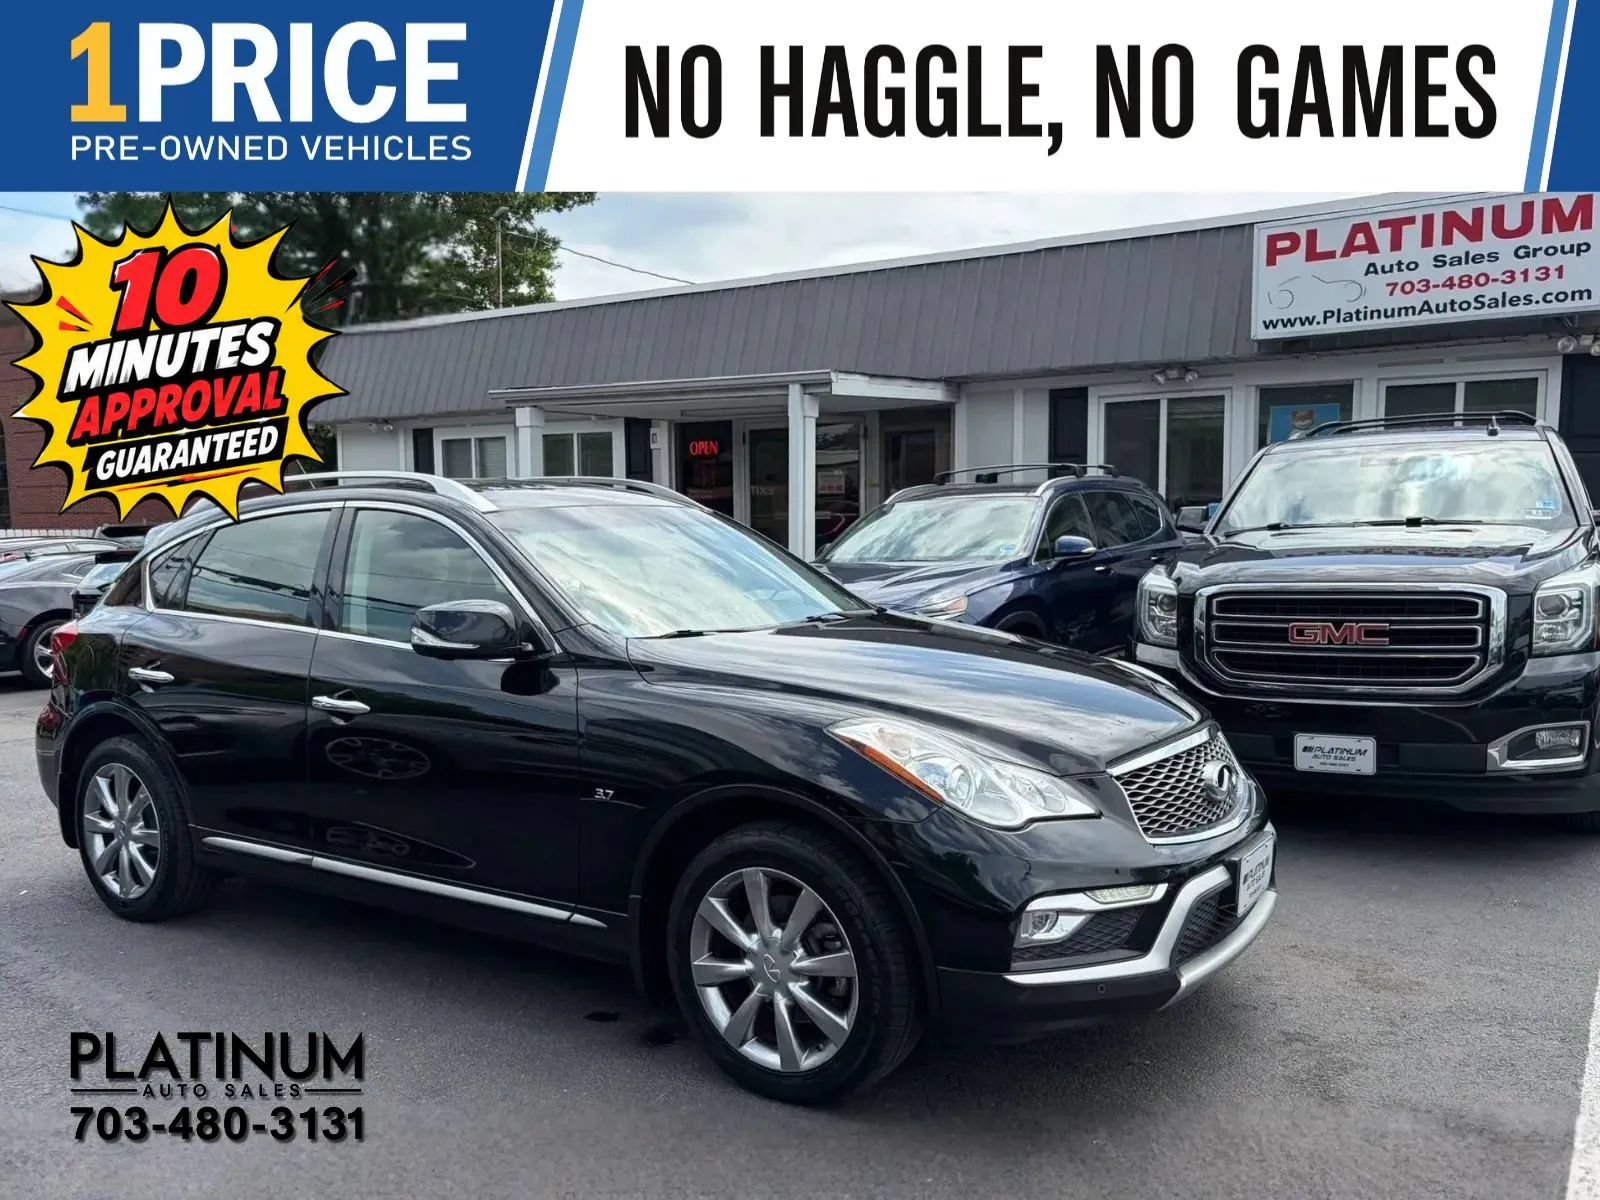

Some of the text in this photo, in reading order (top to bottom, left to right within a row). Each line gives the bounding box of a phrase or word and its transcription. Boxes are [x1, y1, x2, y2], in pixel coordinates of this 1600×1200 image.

[1265, 193, 1594, 267] PLATINUM
[1364, 241, 1592, 277] Auto Sales Group
[1385, 264, 1565, 297] 703-480-3131
[1262, 288, 1593, 331] www.PlatinumAutoSales.com
[689, 440, 718, 456] OPEN
[1288, 622, 1390, 645] GMC
[1313, 746, 1369, 757] PLATINUM
